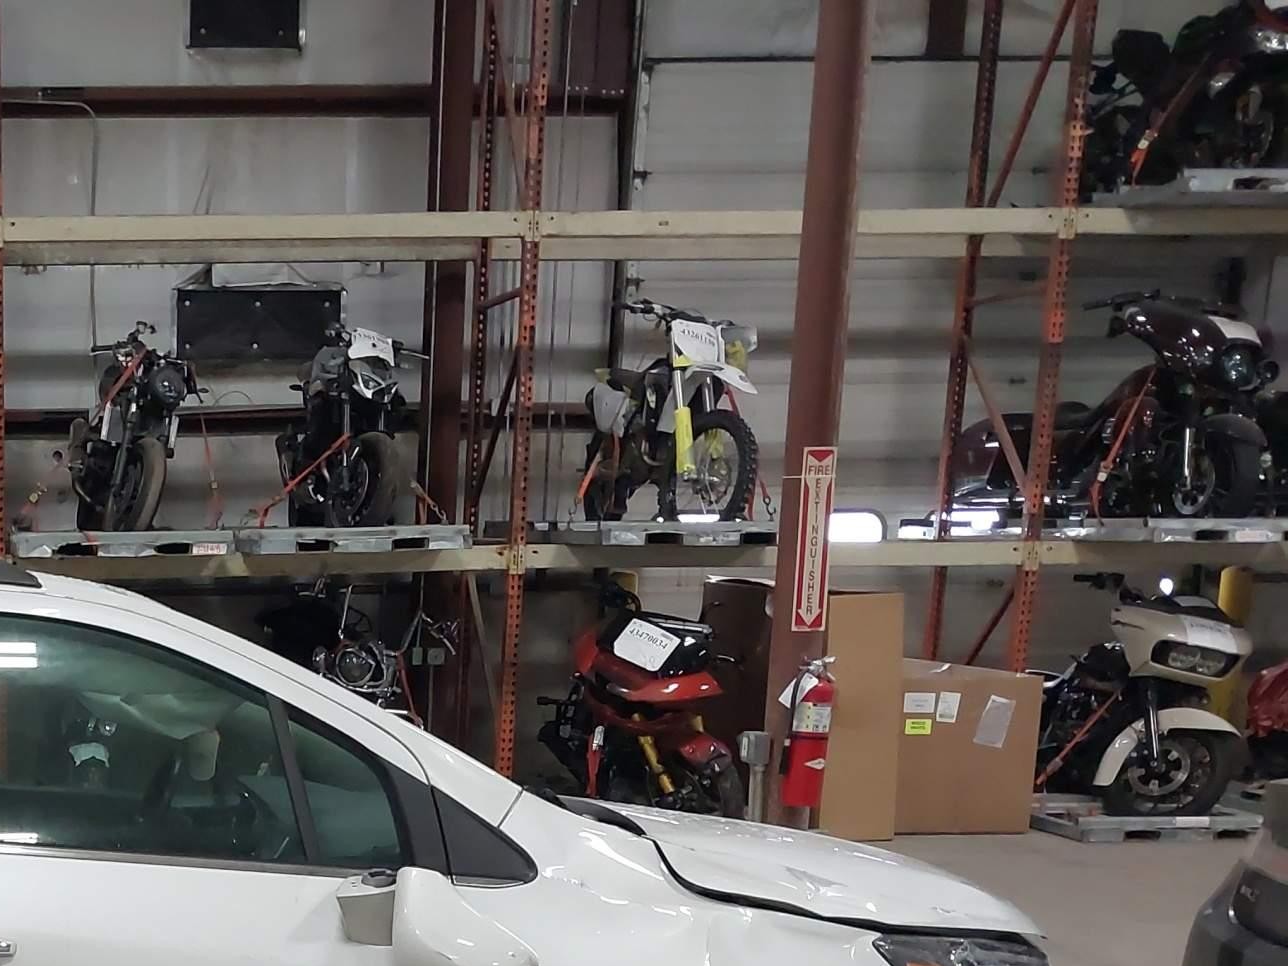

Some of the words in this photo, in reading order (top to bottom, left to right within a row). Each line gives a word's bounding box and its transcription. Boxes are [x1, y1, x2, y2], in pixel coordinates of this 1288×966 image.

[808, 464, 831, 476] FIRE
[806, 478, 822, 616] EXTINGUISHER
[628, 628, 669, 650] 43470034
